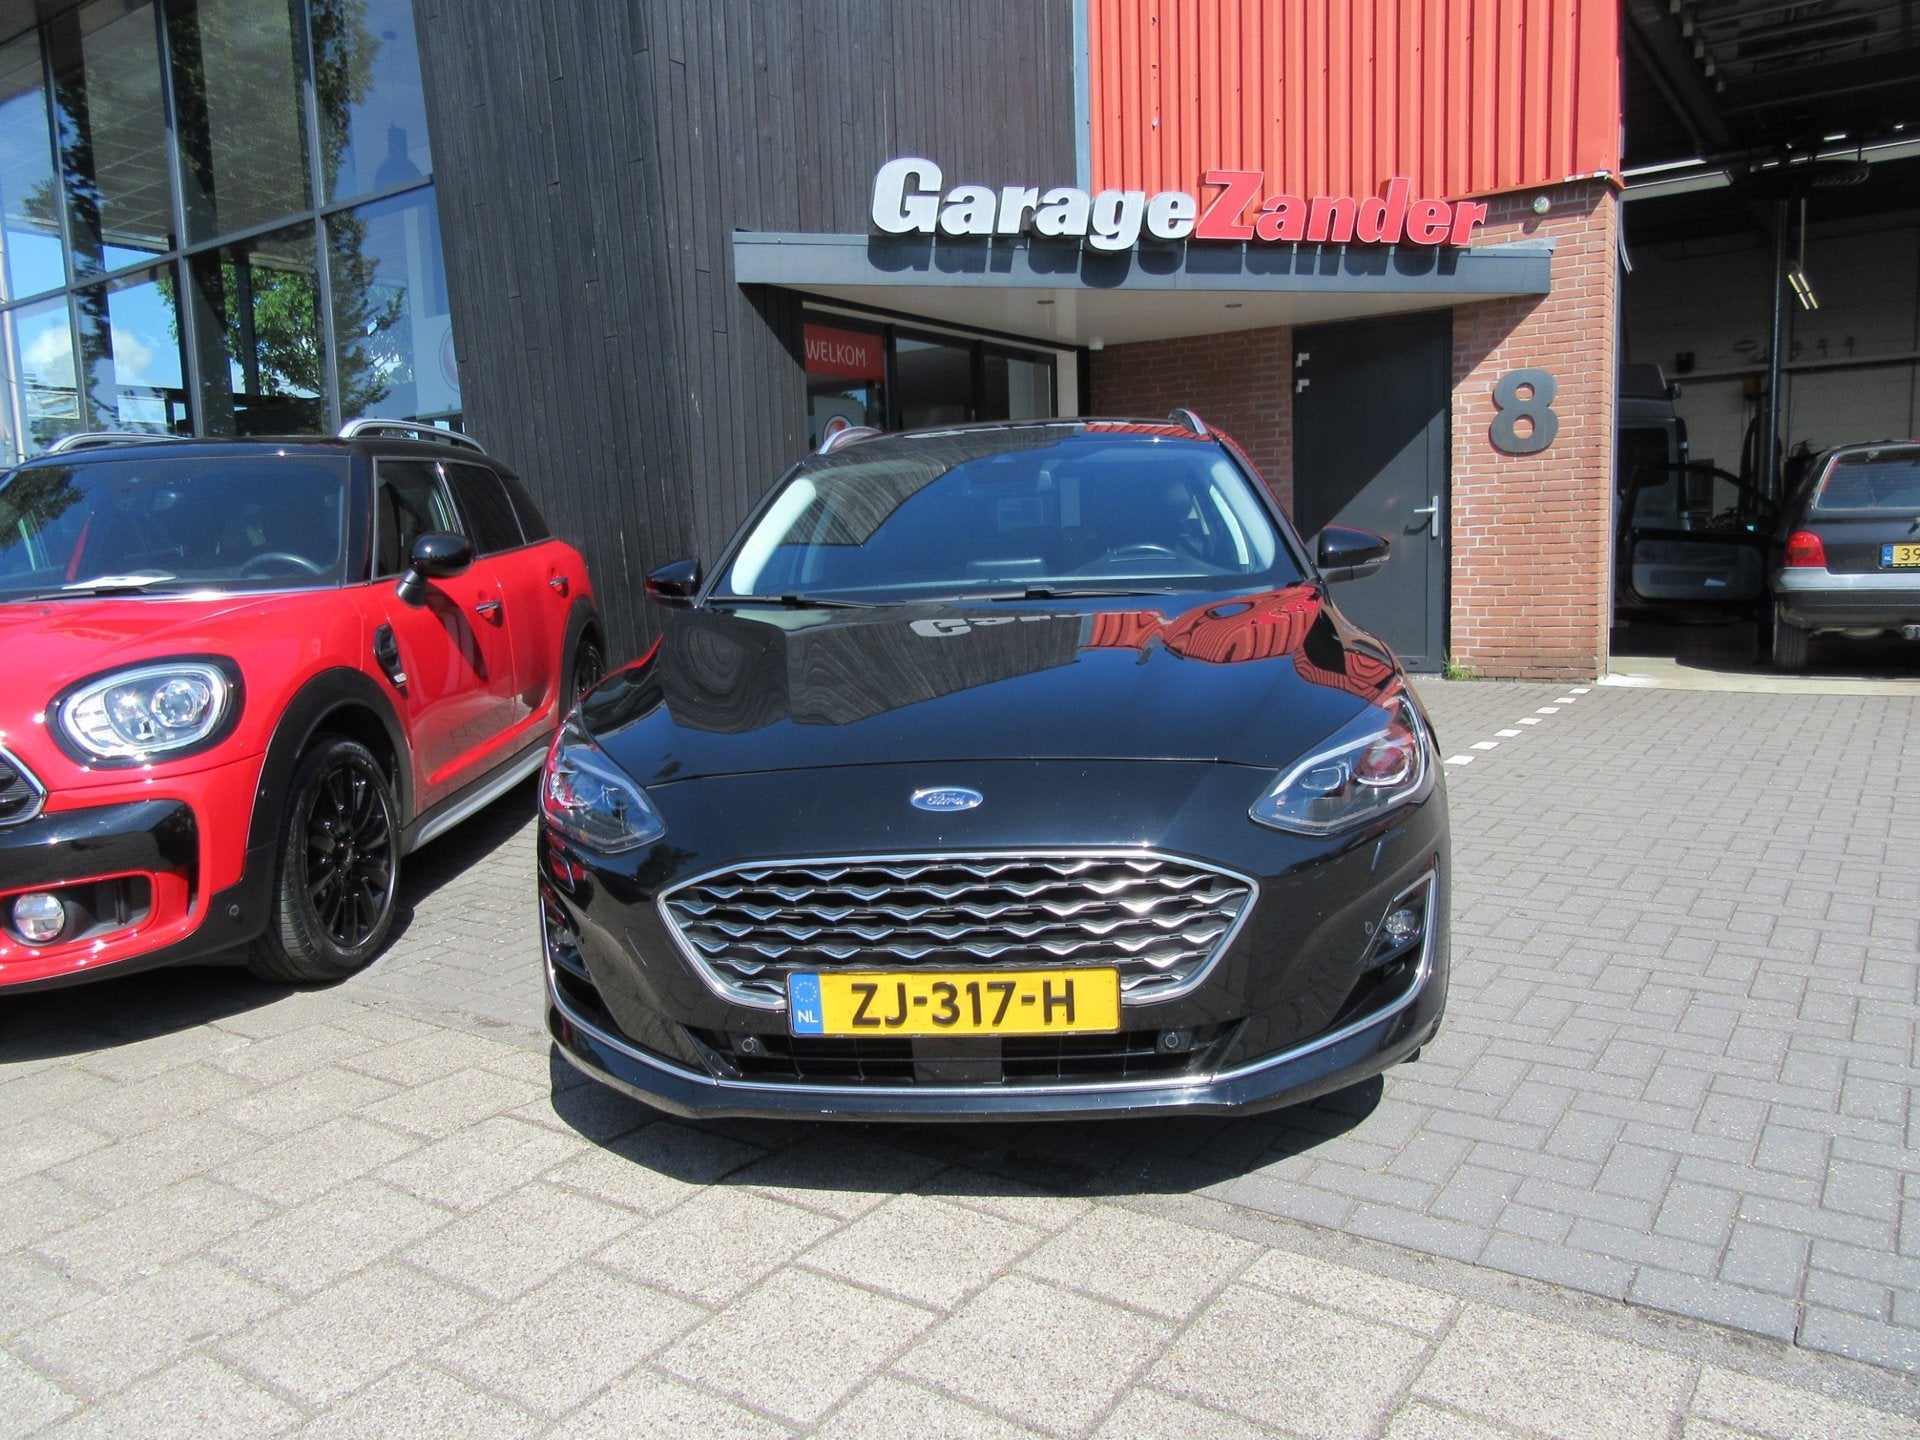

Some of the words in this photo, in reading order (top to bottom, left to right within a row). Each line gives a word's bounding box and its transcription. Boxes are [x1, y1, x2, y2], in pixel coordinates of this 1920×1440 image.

[804, 338, 867, 368] WELKOM
[1488, 368, 1559, 457] 8
[926, 792, 966, 806] Ford
[797, 1010, 819, 1024] NL
[851, 978, 1076, 1028] ZJ-317-H
